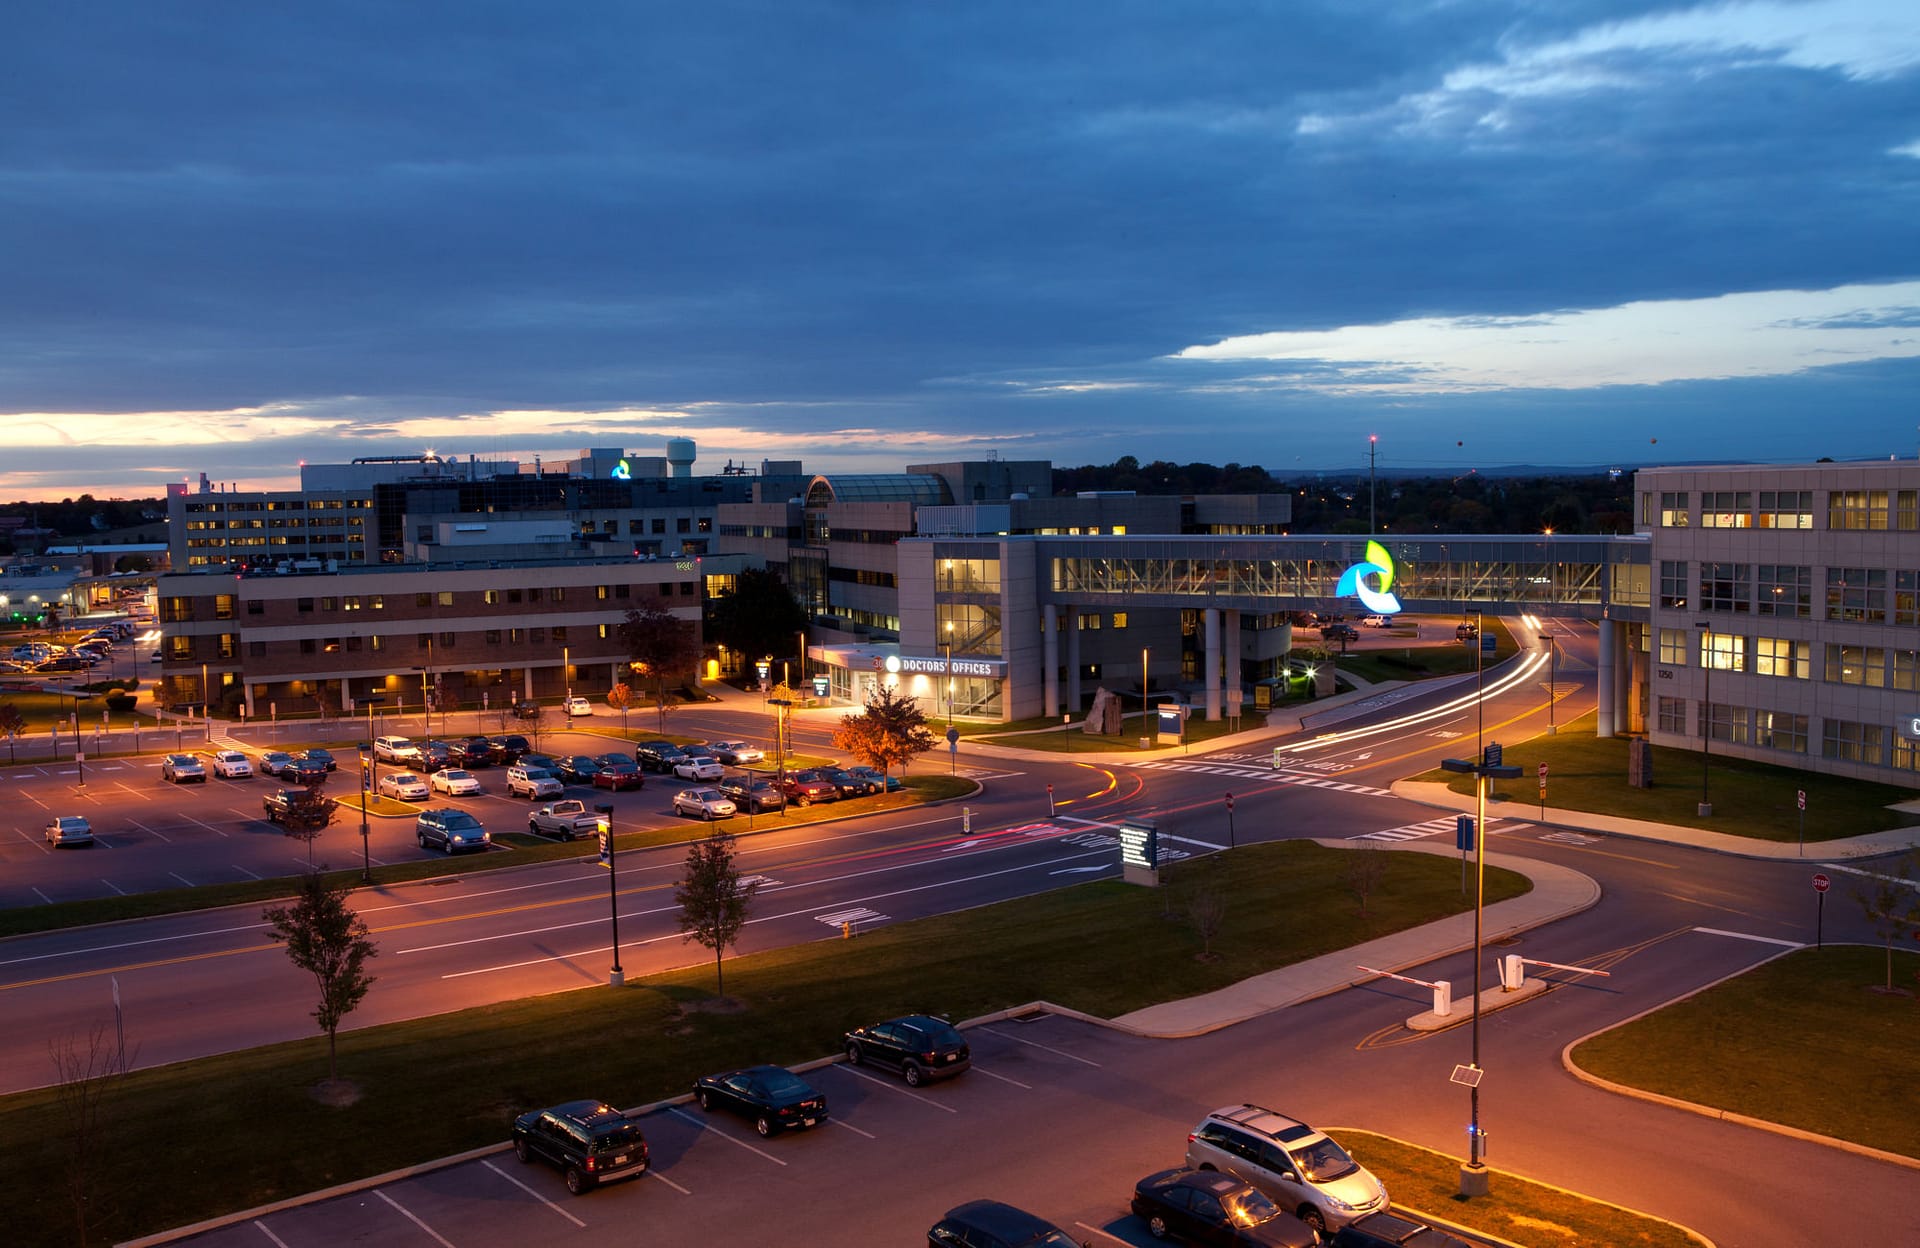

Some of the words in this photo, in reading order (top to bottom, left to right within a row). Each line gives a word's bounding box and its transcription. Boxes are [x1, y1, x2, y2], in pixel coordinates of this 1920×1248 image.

[952, 662, 991, 675] OFFICES
[1658, 670, 1673, 679] 1250
[1813, 879, 1829, 888] STOP
